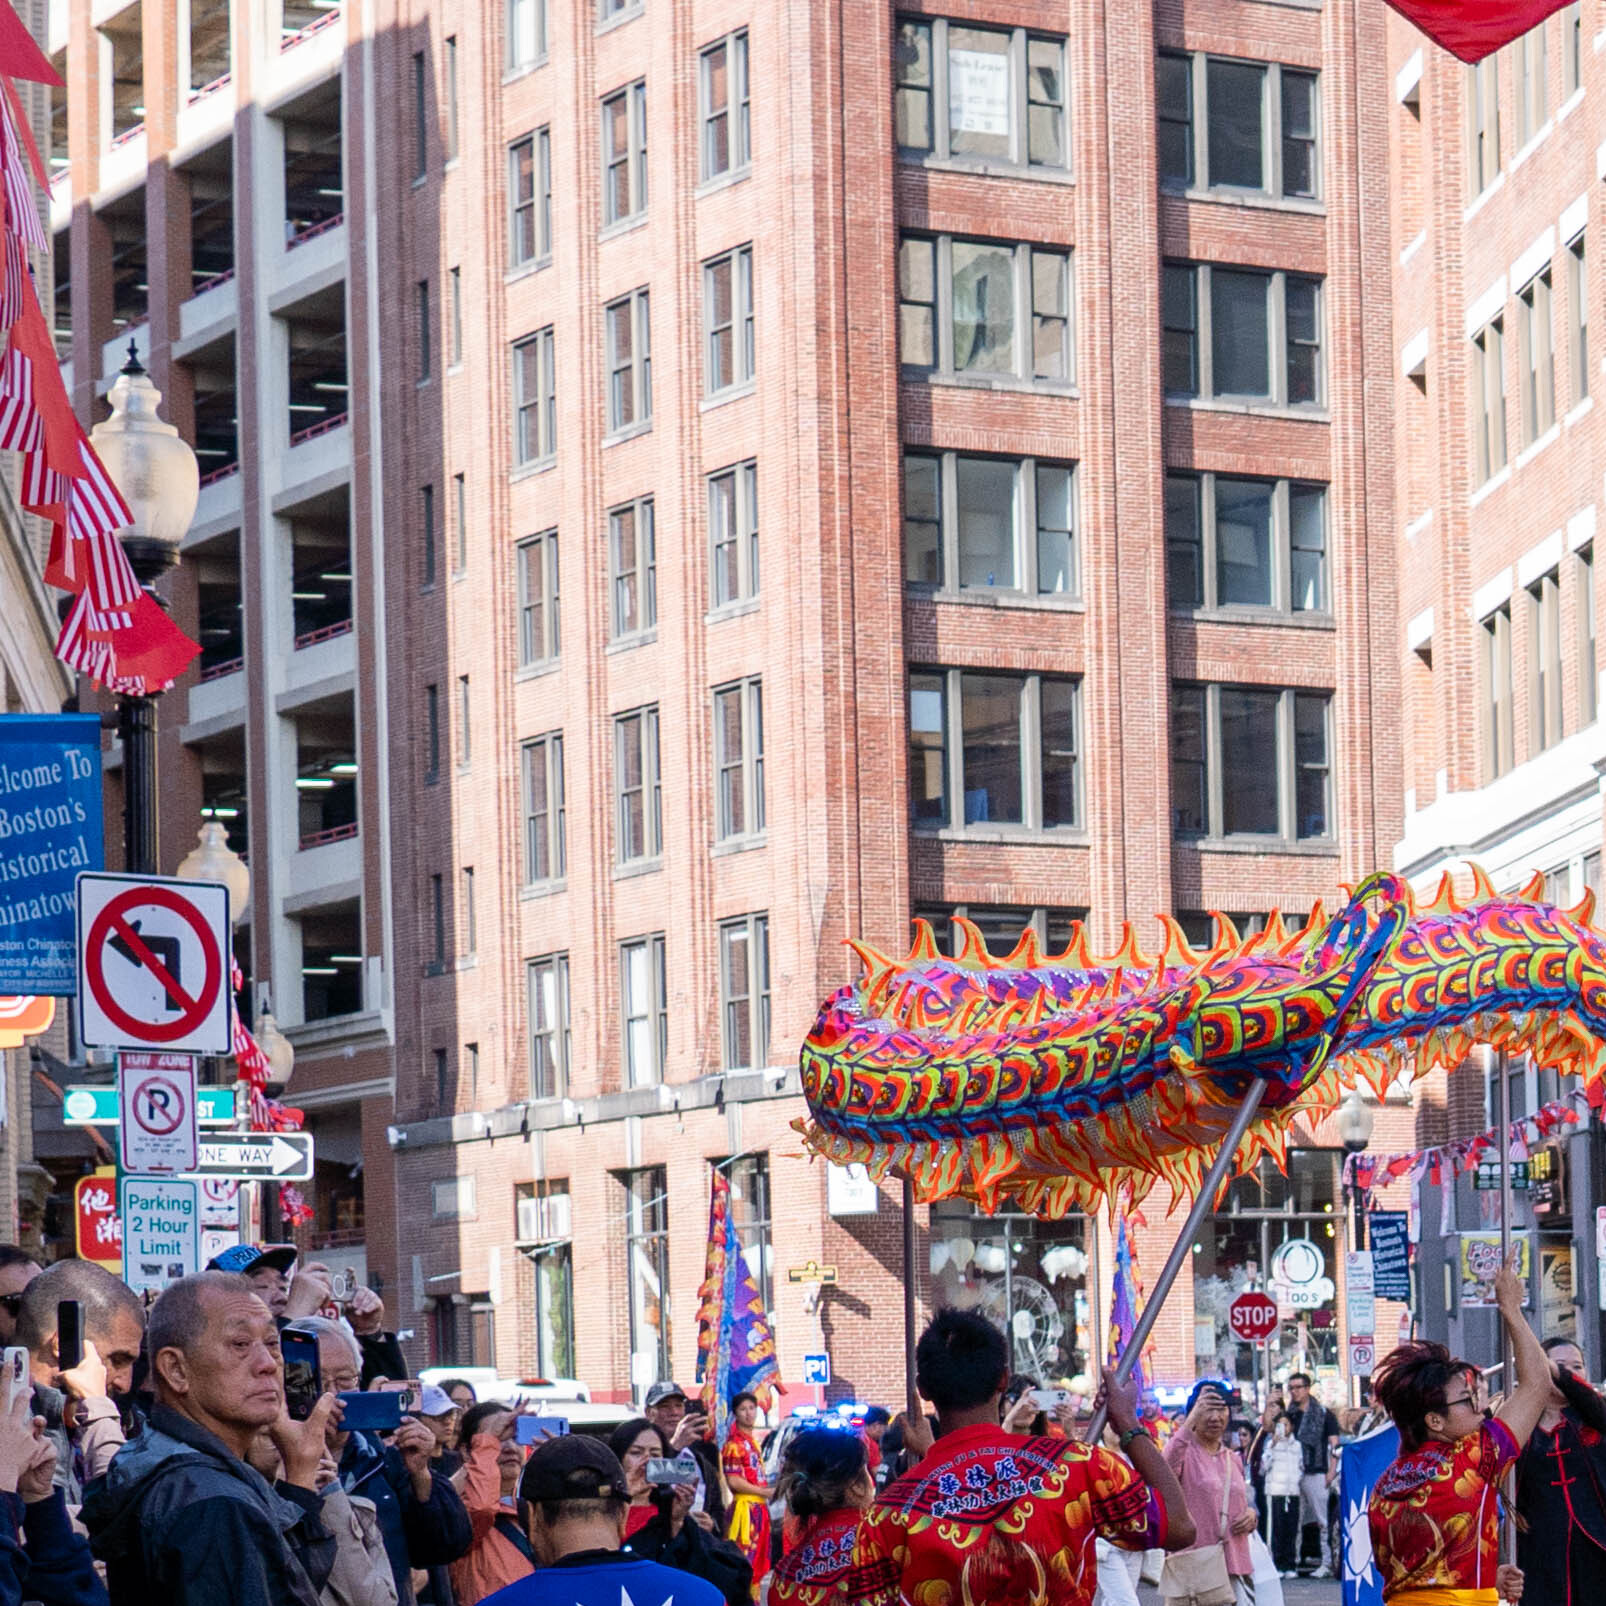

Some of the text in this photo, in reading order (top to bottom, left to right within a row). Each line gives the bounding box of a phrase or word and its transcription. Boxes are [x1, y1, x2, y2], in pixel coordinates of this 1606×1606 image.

[65, 749, 93, 780] To
[198, 1101, 215, 1117] ST
[239, 1149, 272, 1162] WAY
[81, 1188, 115, 1215] 他
[128, 1195, 192, 1214] Parking
[132, 1219, 189, 1233] 2 Hour
[139, 1239, 182, 1255] Limit
[1232, 1306, 1276, 1326] STOP
